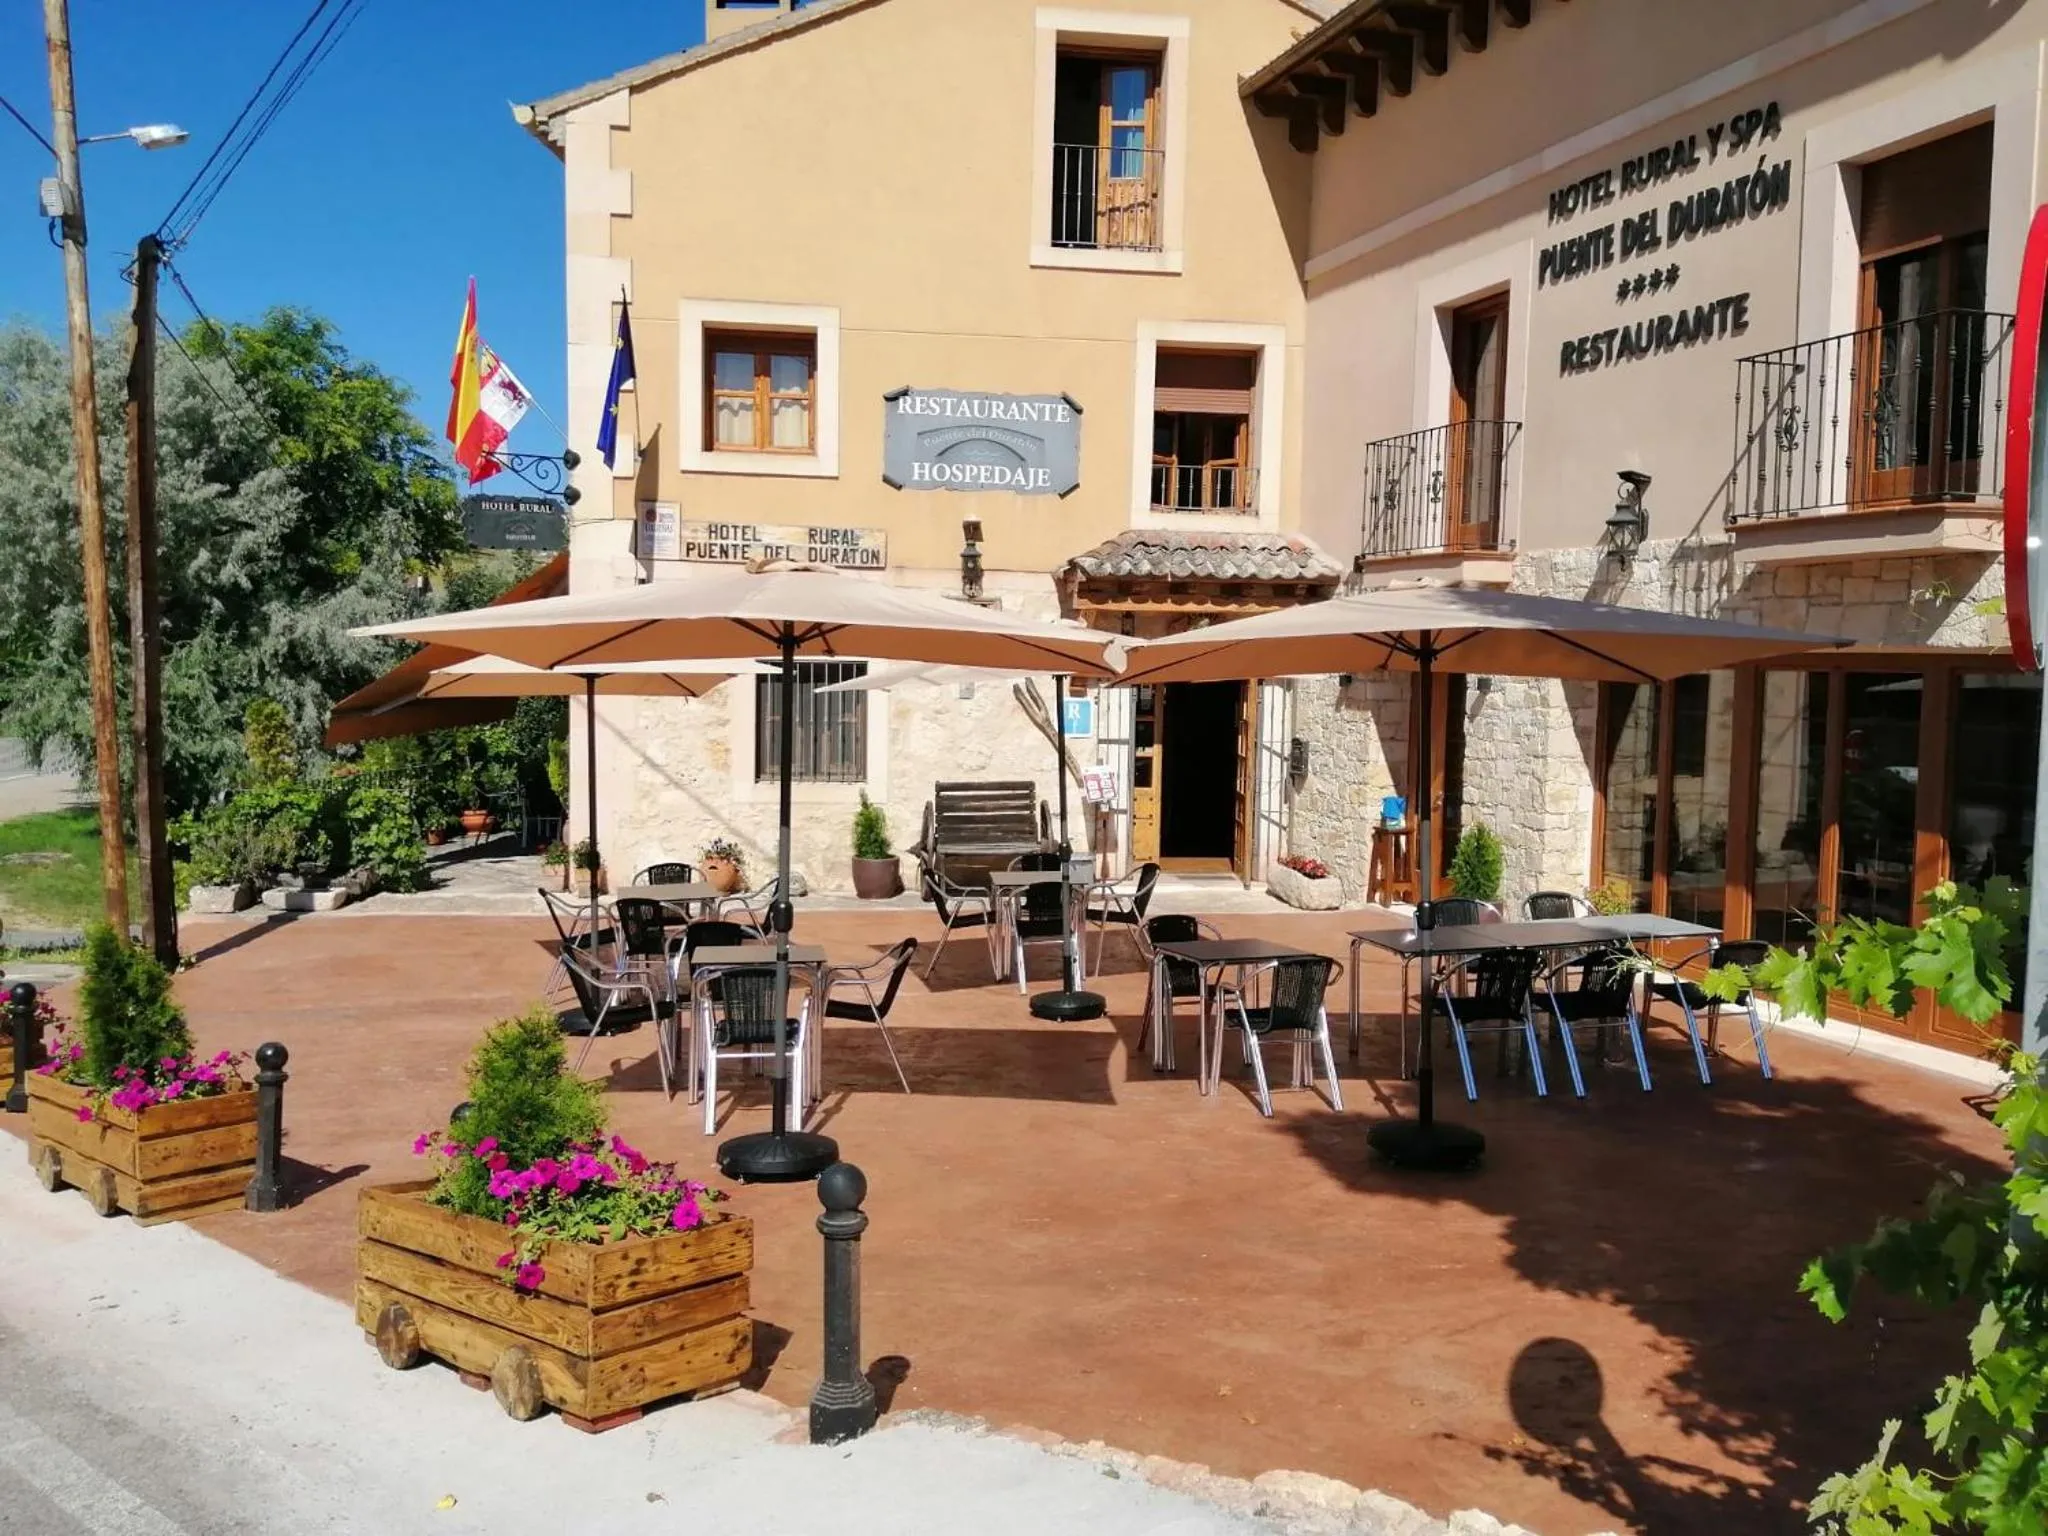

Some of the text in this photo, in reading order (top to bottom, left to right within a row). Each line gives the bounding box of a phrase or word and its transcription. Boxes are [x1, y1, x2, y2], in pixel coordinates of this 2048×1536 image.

[1549, 101, 1782, 222] HOTEL RURAL Y SPA
[1539, 154, 1792, 285] PUENTE DEL DURATÓN
[1560, 292, 1750, 374] RESTAURANTE
[897, 396, 1071, 423] RESTAURANTE
[912, 462, 1050, 490] HOSPEDAJE
[481, 501, 552, 514] HOTEL RURAL
[708, 524, 860, 546] HOTEL RURAL
[686, 542, 750, 560] PUENTE
[764, 545, 798, 562] DEL
[808, 547, 880, 565] DURATON
[1068, 703, 1080, 719] R
